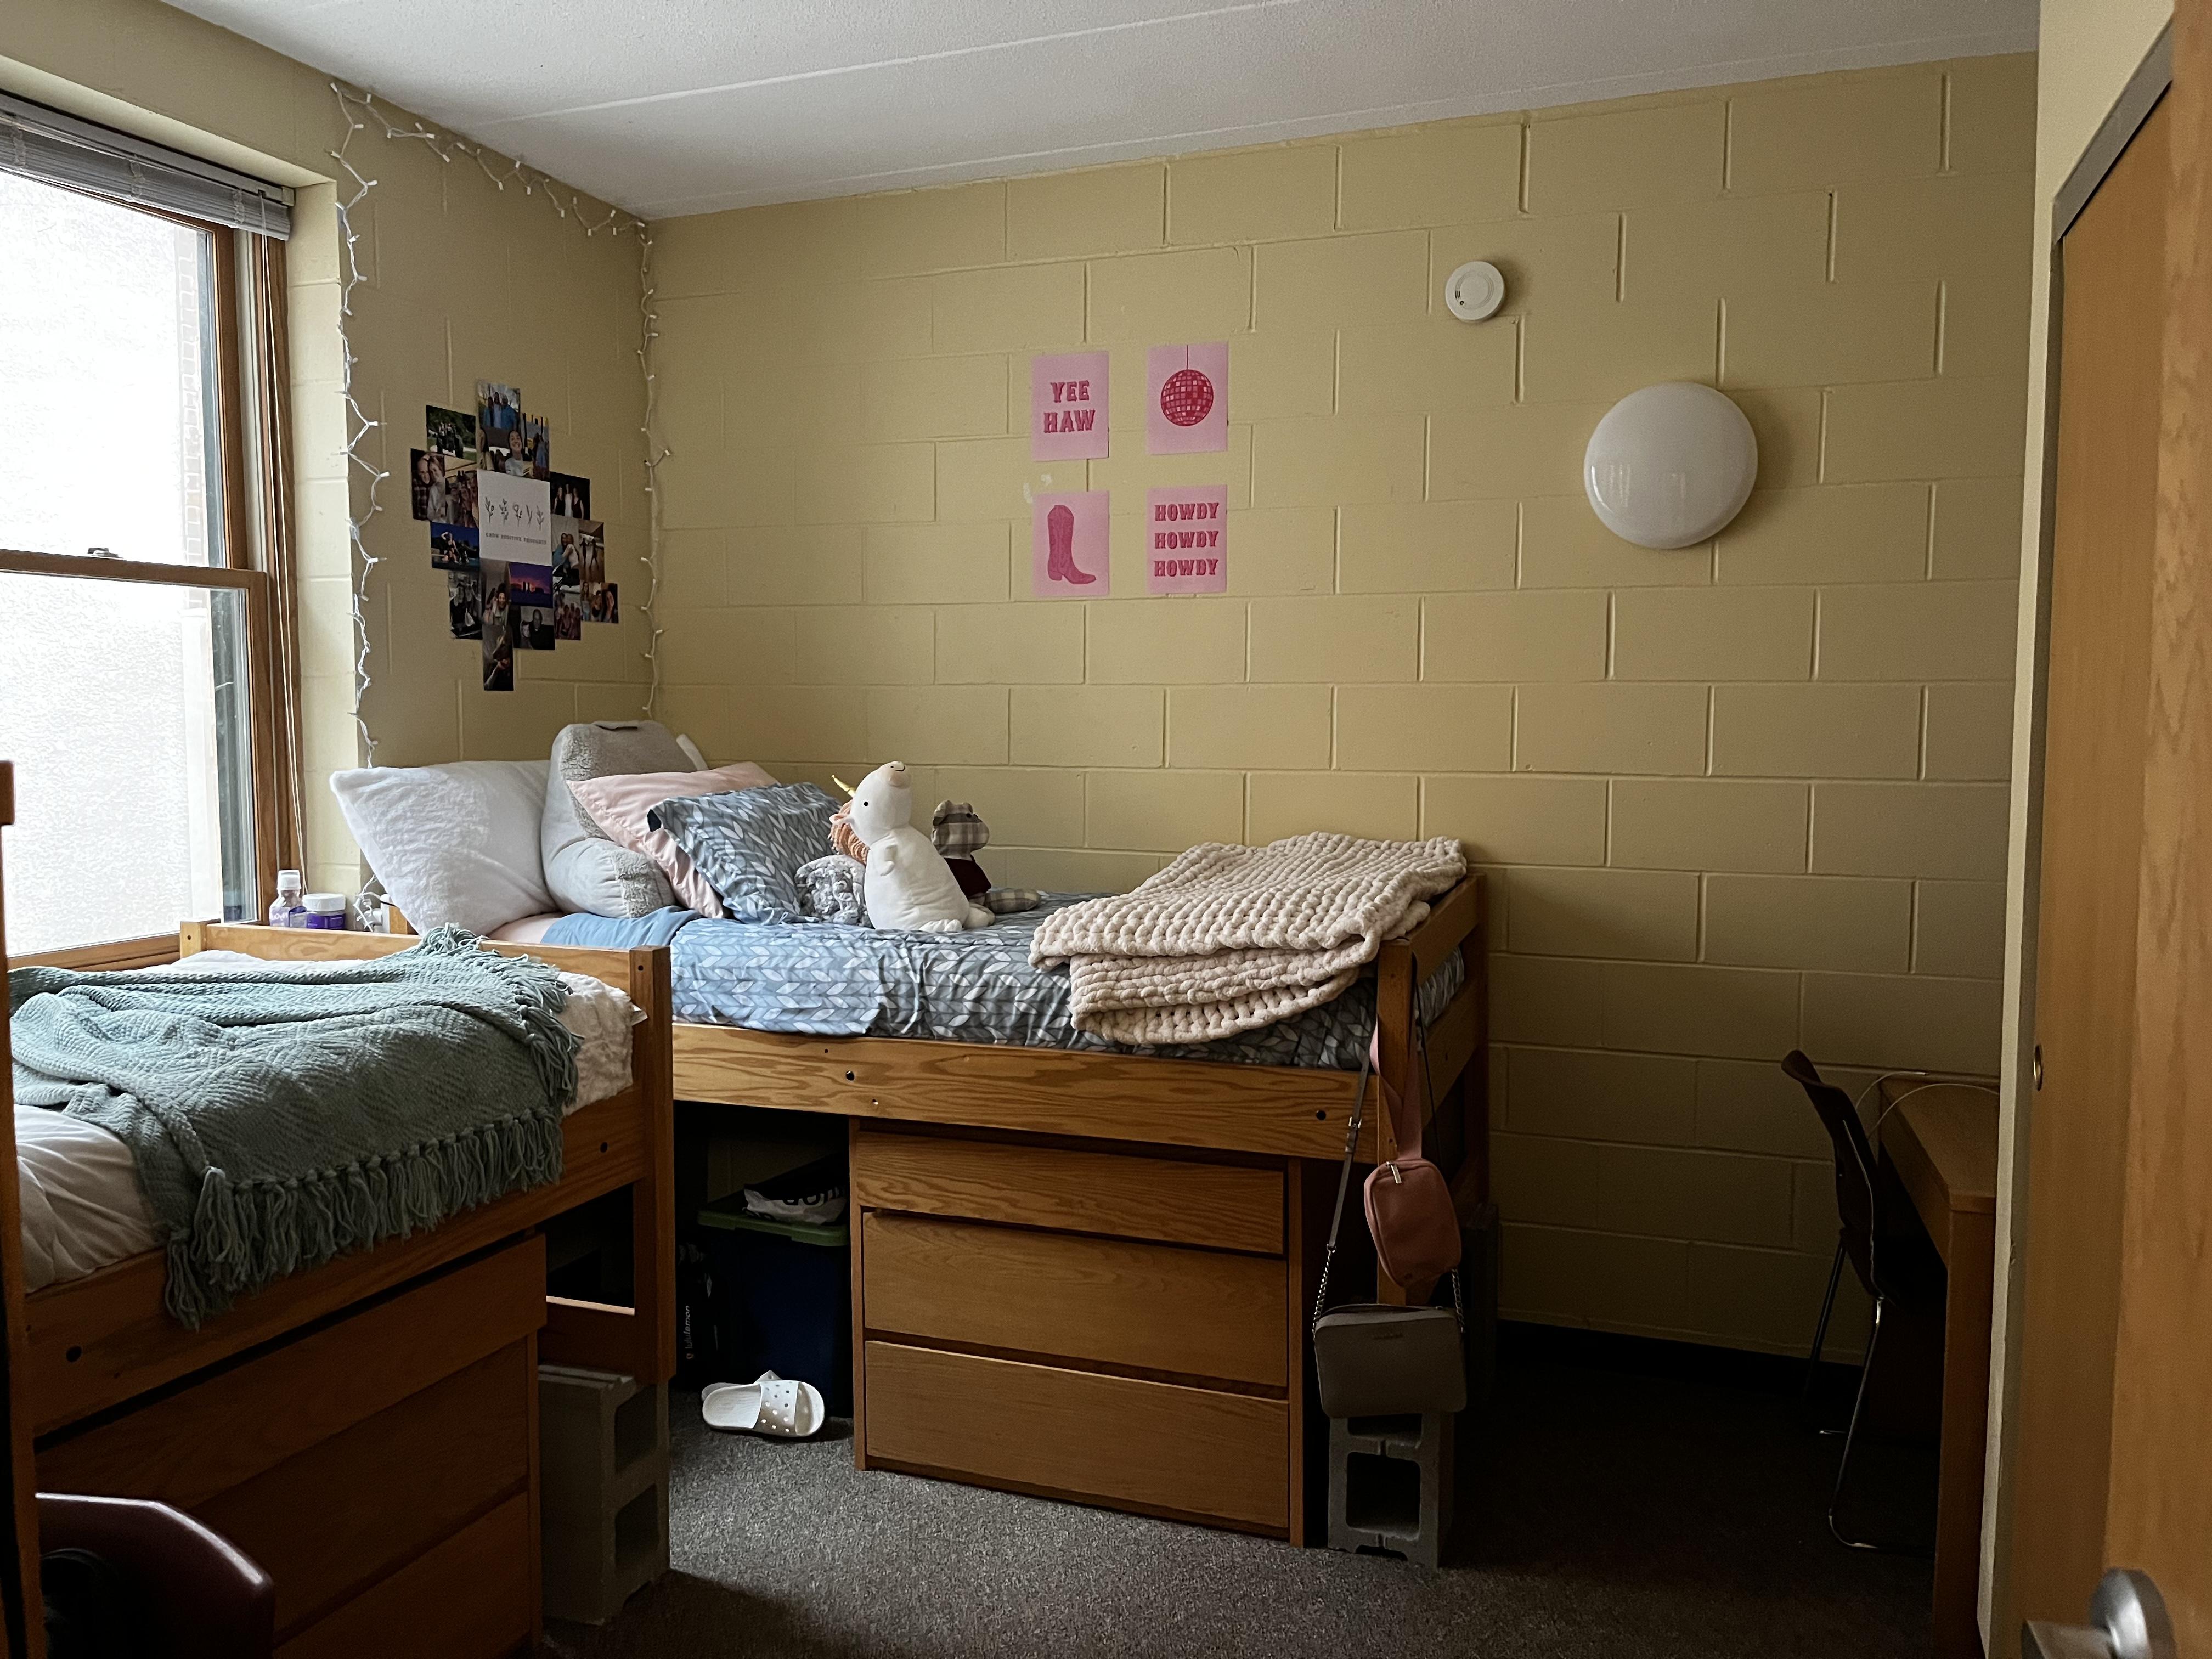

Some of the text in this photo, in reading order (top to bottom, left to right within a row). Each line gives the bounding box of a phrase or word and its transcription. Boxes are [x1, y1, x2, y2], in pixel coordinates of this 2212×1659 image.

[1049, 380, 1090, 403] YEE
[1043, 409, 1096, 433] HAW
[1154, 502, 1219, 521] HOWDY
[1154, 530, 1219, 549] HOWDY
[1154, 558, 1219, 577] HOWDY
[684, 1305, 692, 1349] lululemon
